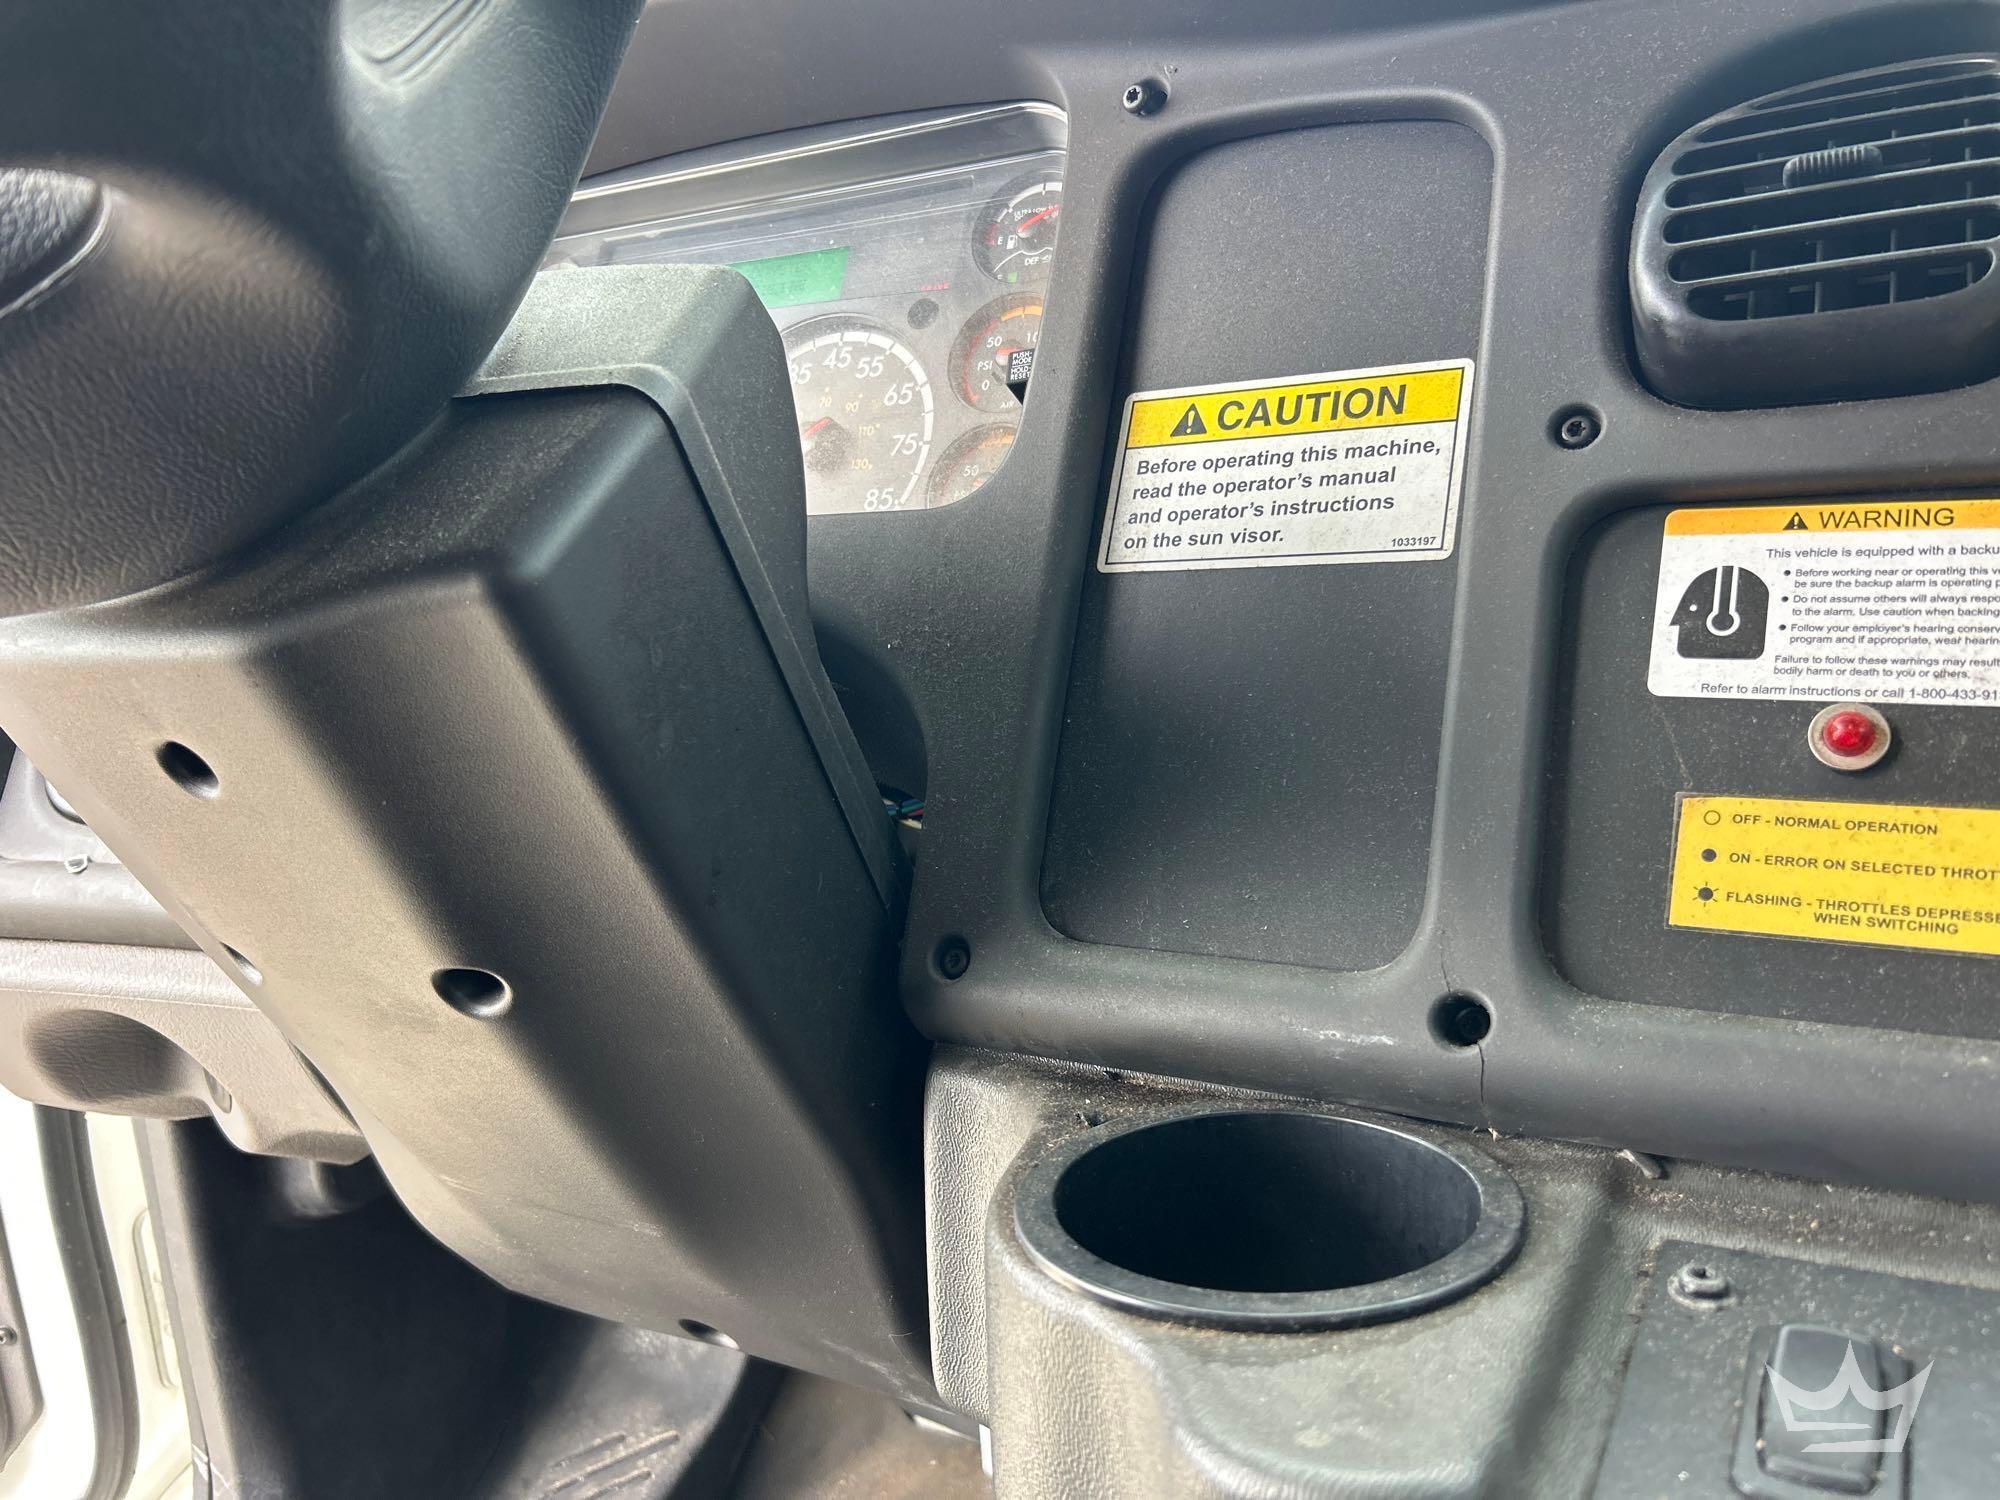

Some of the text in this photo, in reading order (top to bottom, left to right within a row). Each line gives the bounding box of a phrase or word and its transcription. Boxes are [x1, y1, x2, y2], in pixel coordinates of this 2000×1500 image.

[986, 336, 1003, 348] 50
[823, 347, 854, 368] 45
[855, 356, 886, 379] 55
[977, 360, 993, 371] PSI
[883, 382, 915, 407] 65
[981, 379, 990, 391] 0
[1217, 384, 1407, 431] CAUTION
[890, 432, 919, 457] 75
[1137, 438, 1441, 476] Before operating this machine,
[1132, 466, 1396, 500] read the operator's manual
[863, 487, 895, 512] 85
[1127, 494, 1395, 525] and operator's instructions
[1818, 507, 1955, 530] WARNING
[1123, 526, 1284, 550] on the sun visor.
[1390, 536, 1437, 548] 1033197
[1765, 548, 1791, 558] This
[1795, 547, 1838, 558] vehicle
[1841, 547, 1852, 557] is
[1855, 546, 1915, 559] equipped
[1918, 545, 1944, 556] with
[1948, 546, 1956, 555] a
[1795, 568, 1829, 577] Before
[1832, 567, 1872, 578] working
[1875, 568, 1899, 577] near
[1901, 568, 1913, 577] or
[1915, 566, 1966, 577] operating
[1969, 566, 1989, 575] this
[1794, 579, 1807, 588] be
[1809, 580, 1833, 588] sure
[1835, 579, 1852, 588] the
[1854, 579, 1893, 589] backup
[1895, 579, 1926, 588] alarm
[1928, 578, 1938, 588] is
[1940, 578, 1992, 589] operating
[1793, 594, 1808, 603] Do
[1810, 595, 1827, 603] not
[1829, 595, 1871, 603] assume
[1873, 595, 1907, 603] others
[1909, 594, 1928, 603] will
[1930, 594, 1968, 605] always
[1792, 607, 2000, 618] to the alarm. Use caution when backing
[1790, 623, 1824, 632] Follow
[1826, 624, 1850, 634] your
[1913, 624, 1955, 635] hearing
[1789, 635, 1833, 645] program
[1835, 635, 1855, 644] and
[1857, 635, 1865, 644] if
[1867, 635, 1932, 647] appropriate,
[1934, 636, 1962, 645] wear
[1774, 654, 2000, 668] Failure to follow these warnings may result
[1773, 666, 1971, 679] bodily harm or death to you or others.
[1700, 683, 2000, 701] Refer to alarm instructions or call 1-800-433-91
[1732, 813, 1761, 825] OFF
[1774, 815, 1840, 830] NORMAL
[1846, 819, 1938, 836] OPERATION
[1729, 852, 1751, 864] ON
[1763, 855, 1818, 869] ERROR
[1823, 858, 1846, 871] ON
[1850, 860, 1936, 877] SELECTED
[1726, 891, 1801, 908] FLASHING
[1815, 898, 1911, 917] THROTTLES
[1813, 911, 1959, 935] WHEN SWITCHING
